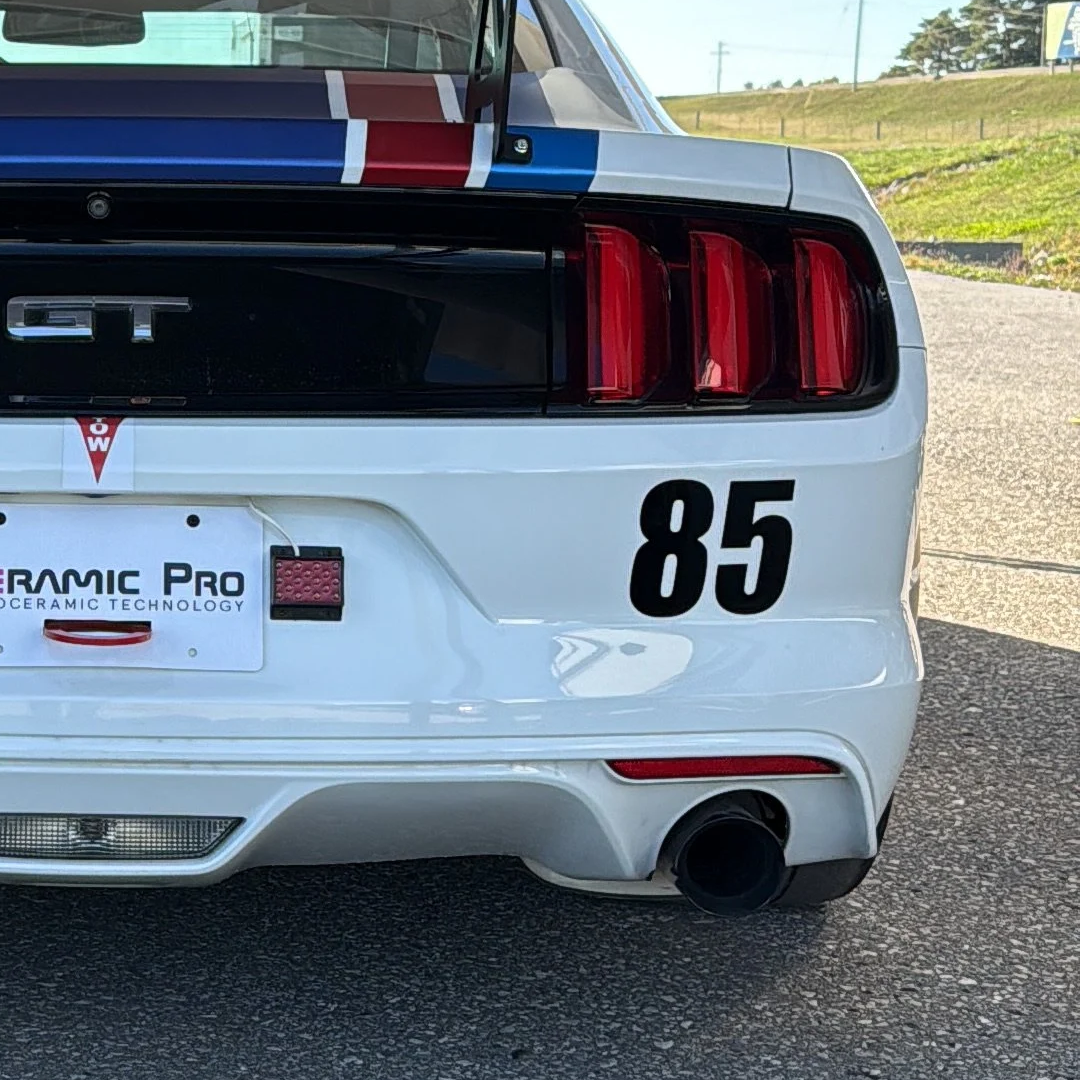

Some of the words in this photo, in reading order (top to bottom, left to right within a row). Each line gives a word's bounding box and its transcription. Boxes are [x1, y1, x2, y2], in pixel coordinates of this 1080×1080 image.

[6, 295, 192, 343] GT
[629, 478, 796, 617] 85
[163, 562, 245, 597] PRO
[110, 598, 245, 613] TECHNOLOGY
